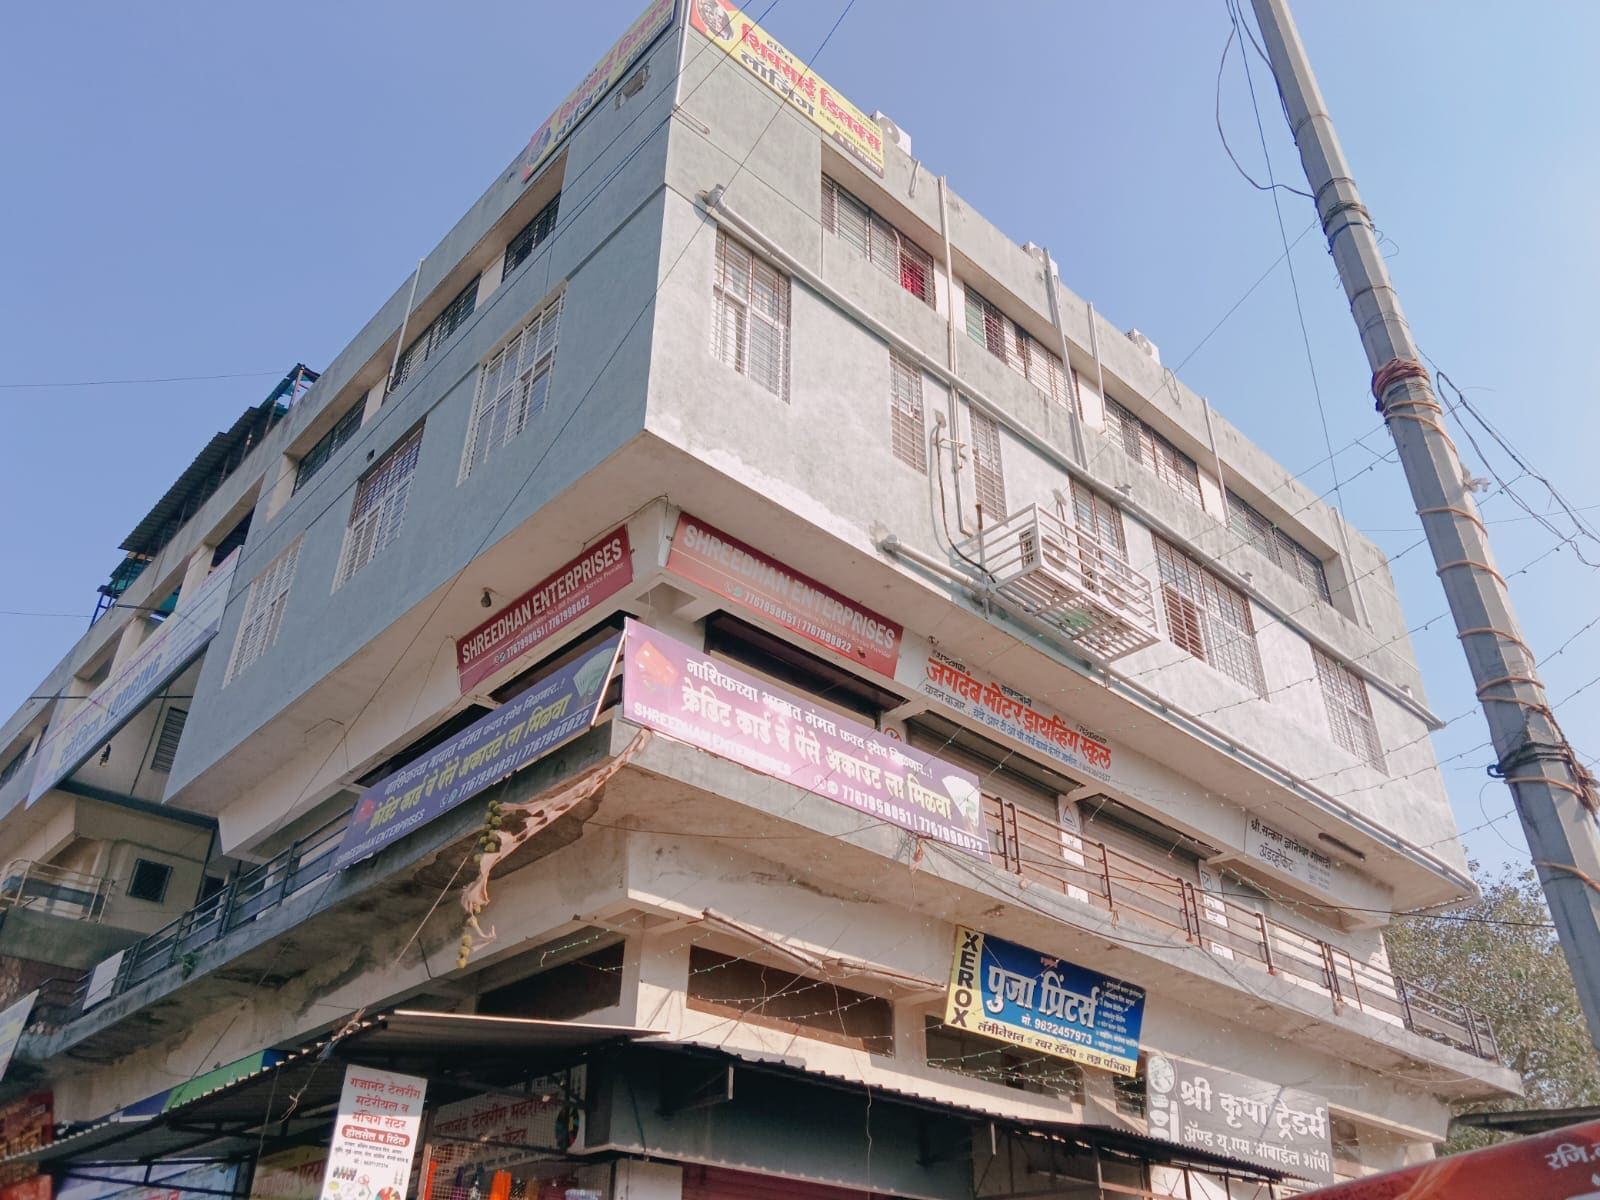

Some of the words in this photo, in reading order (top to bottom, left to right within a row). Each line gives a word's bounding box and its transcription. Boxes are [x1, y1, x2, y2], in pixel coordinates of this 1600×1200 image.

[742, 23, 816, 102] शिवसाई
[742, 50, 814, 117] लॉजिंग
[463, 602, 529, 662] SHREEDHAN
[535, 538, 619, 613] ENTERPRISES
[686, 525, 787, 596] SHREEDHAN
[794, 581, 892, 649] ENTERPRISES
[803, 620, 850, 653] 7767998022
[688, 654, 755, 702] नाशिकच्या
[805, 706, 836, 737] गंमत
[926, 657, 982, 704] जगदंब
[984, 682, 1023, 724] मोटर
[1023, 708, 1080, 754] ड्रायव्हिंग
[1080, 736, 1111, 769] स्कूल
[459, 732, 505, 777] अकाउंट
[505, 724, 524, 748] ला
[524, 694, 573, 738] मिळवा
[683, 678, 730, 729] क्रेडिट
[736, 700, 771, 744] कार्ड
[775, 720, 791, 752] चे
[794, 726, 820, 764] पैसे
[827, 741, 880, 789] अकाउंट
[886, 771, 904, 800] ला
[907, 774, 952, 819] मिळवा
[952, 931, 979, 1028] XEROX
[986, 965, 1037, 1014] पुजा
[1039, 970, 1100, 1028] प्रिंटर्स
[1020, 1012, 1032, 1027] मो.
[1034, 1019, 1092, 1045] 9822457973
[350, 1074, 385, 1092] गजानंद
[1103, 1055, 1131, 1074] पत्रिका
[386, 1134, 405, 1144] रिटेल
[401, 1103, 409, 1112] व
[1180, 1077, 1211, 1112] श्री
[1219, 1093, 1268, 1128] कृपा
[1275, 1099, 1326, 1141] ट्रेडर्स
[1304, 1150, 1330, 1173] शॉपी
